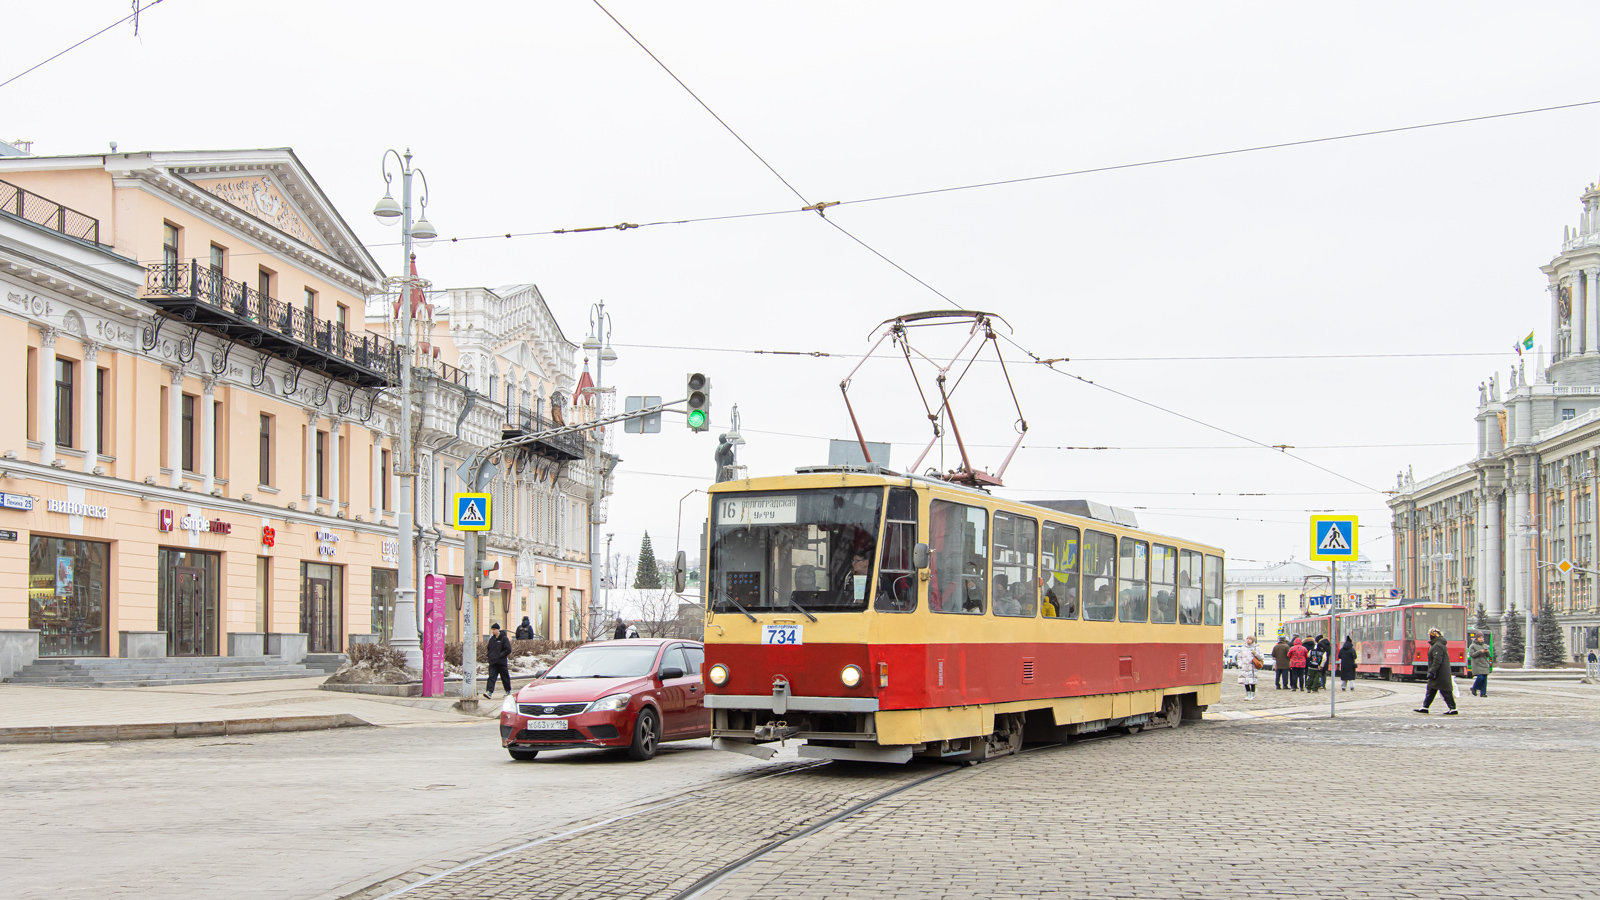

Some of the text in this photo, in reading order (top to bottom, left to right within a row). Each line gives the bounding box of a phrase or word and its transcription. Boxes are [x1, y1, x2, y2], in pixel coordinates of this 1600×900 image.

[6, 498, 32, 508] Ленина 25
[723, 502, 736, 518] 16
[768, 629, 797, 644] 734
